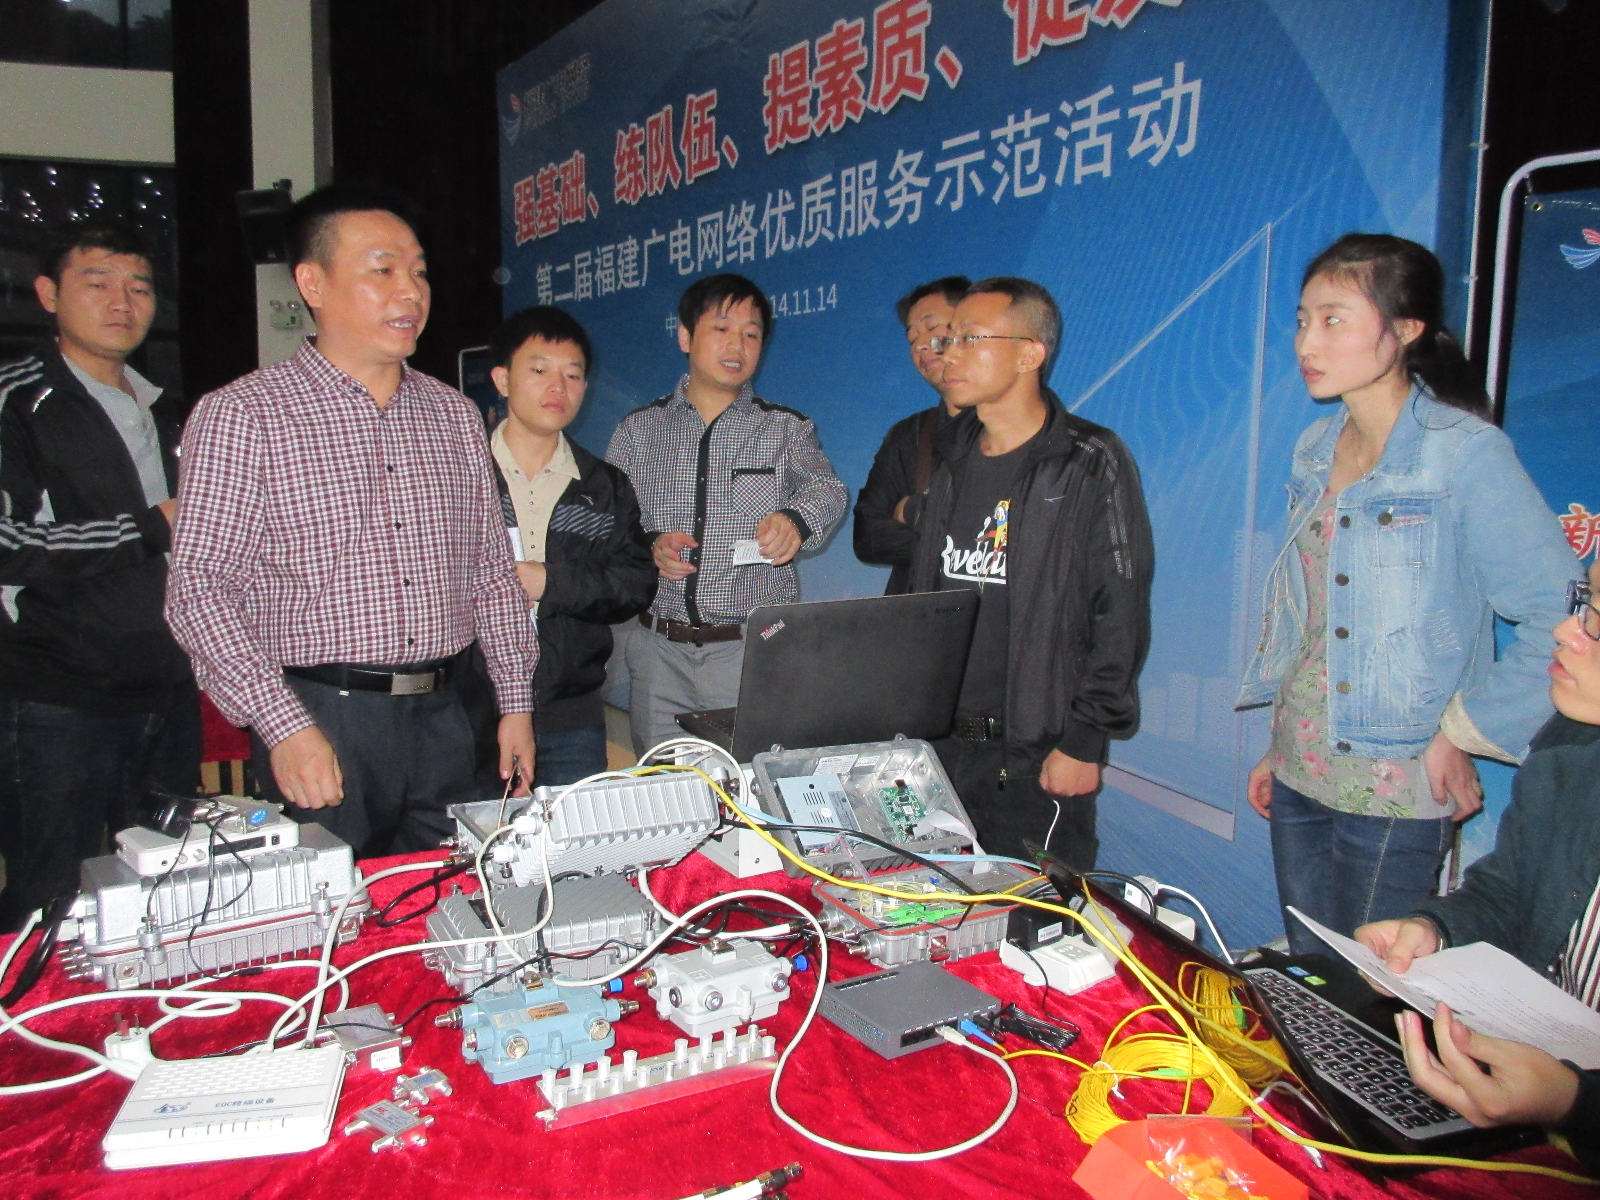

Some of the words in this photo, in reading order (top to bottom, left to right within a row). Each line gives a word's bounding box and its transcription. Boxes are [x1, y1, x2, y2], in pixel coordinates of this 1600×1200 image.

[536, 61, 1202, 305] 第二届福建广电网络优质服务示范活动
[768, 283, 838, 319] 14.11.14
[760, 619, 785, 640] ThinkPad
